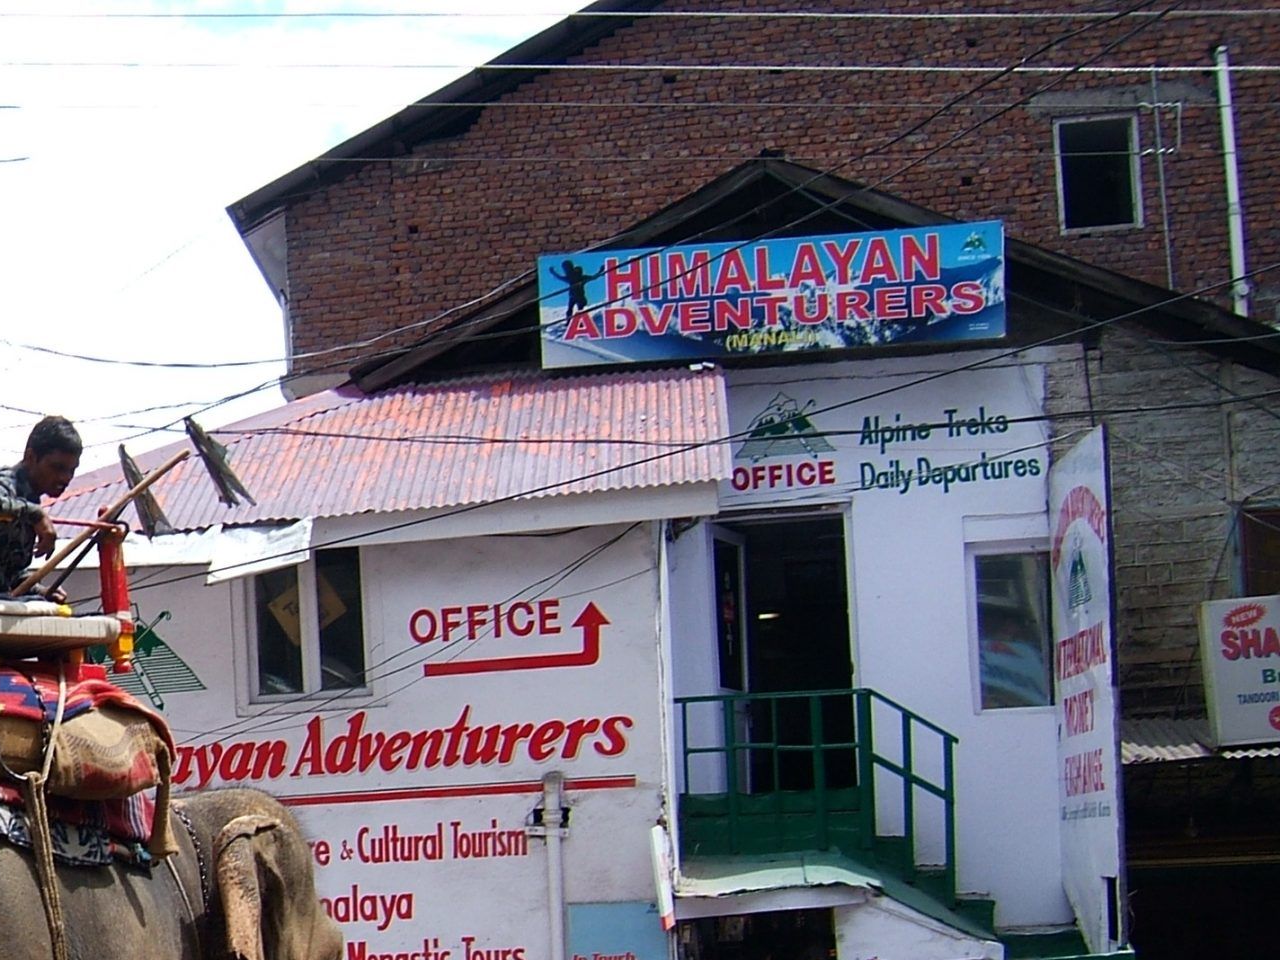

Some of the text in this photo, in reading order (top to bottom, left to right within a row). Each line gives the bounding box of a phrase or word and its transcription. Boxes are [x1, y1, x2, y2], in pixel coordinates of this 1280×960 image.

[604, 232, 941, 300] HIMALAYAN
[565, 281, 987, 341] ADVENTURERS
[860, 406, 1008, 454] Alpine Treks
[731, 460, 836, 492] OFFICE
[860, 452, 1041, 494] Daily Departures
[409, 599, 563, 644] OFFICE
[1231, 608, 1258, 624] NEW
[1220, 627, 1280, 661] SHA
[290, 705, 634, 777] Adventurers
[340, 839, 354, 861] &
[356, 822, 444, 864] Cultural
[450, 818, 529, 859] Tourism
